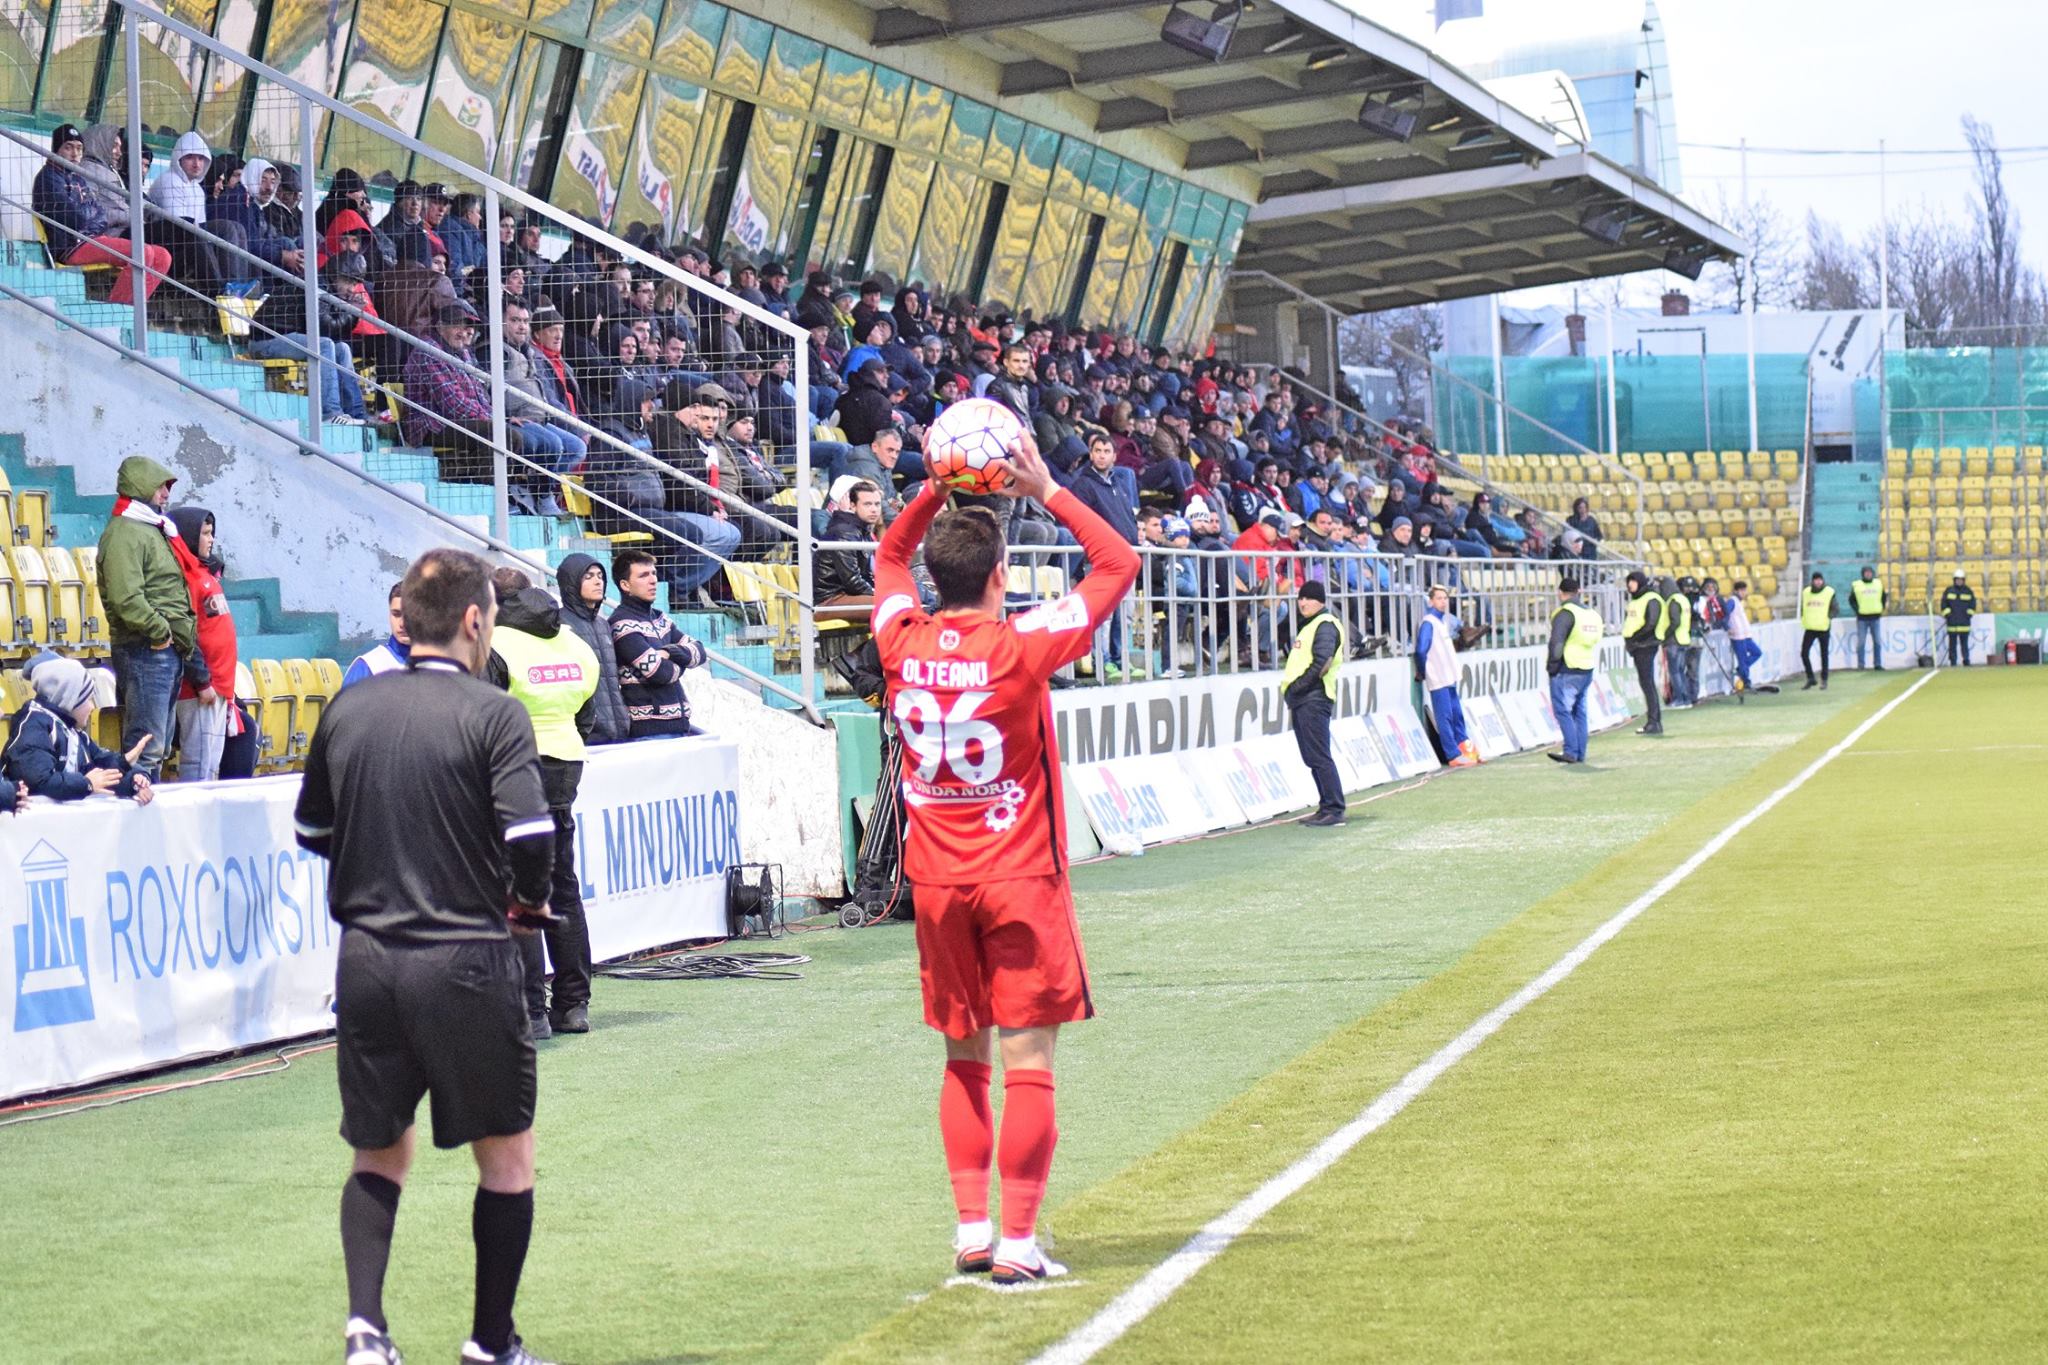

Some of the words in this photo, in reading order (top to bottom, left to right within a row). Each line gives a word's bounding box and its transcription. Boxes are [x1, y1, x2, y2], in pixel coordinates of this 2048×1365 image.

[544, 668, 580, 680] SAS
[902, 658, 988, 688] OLTEANU
[894, 688, 1004, 785] 96
[961, 779, 1017, 797] NORD
[602, 789, 741, 896] MINUNILOR
